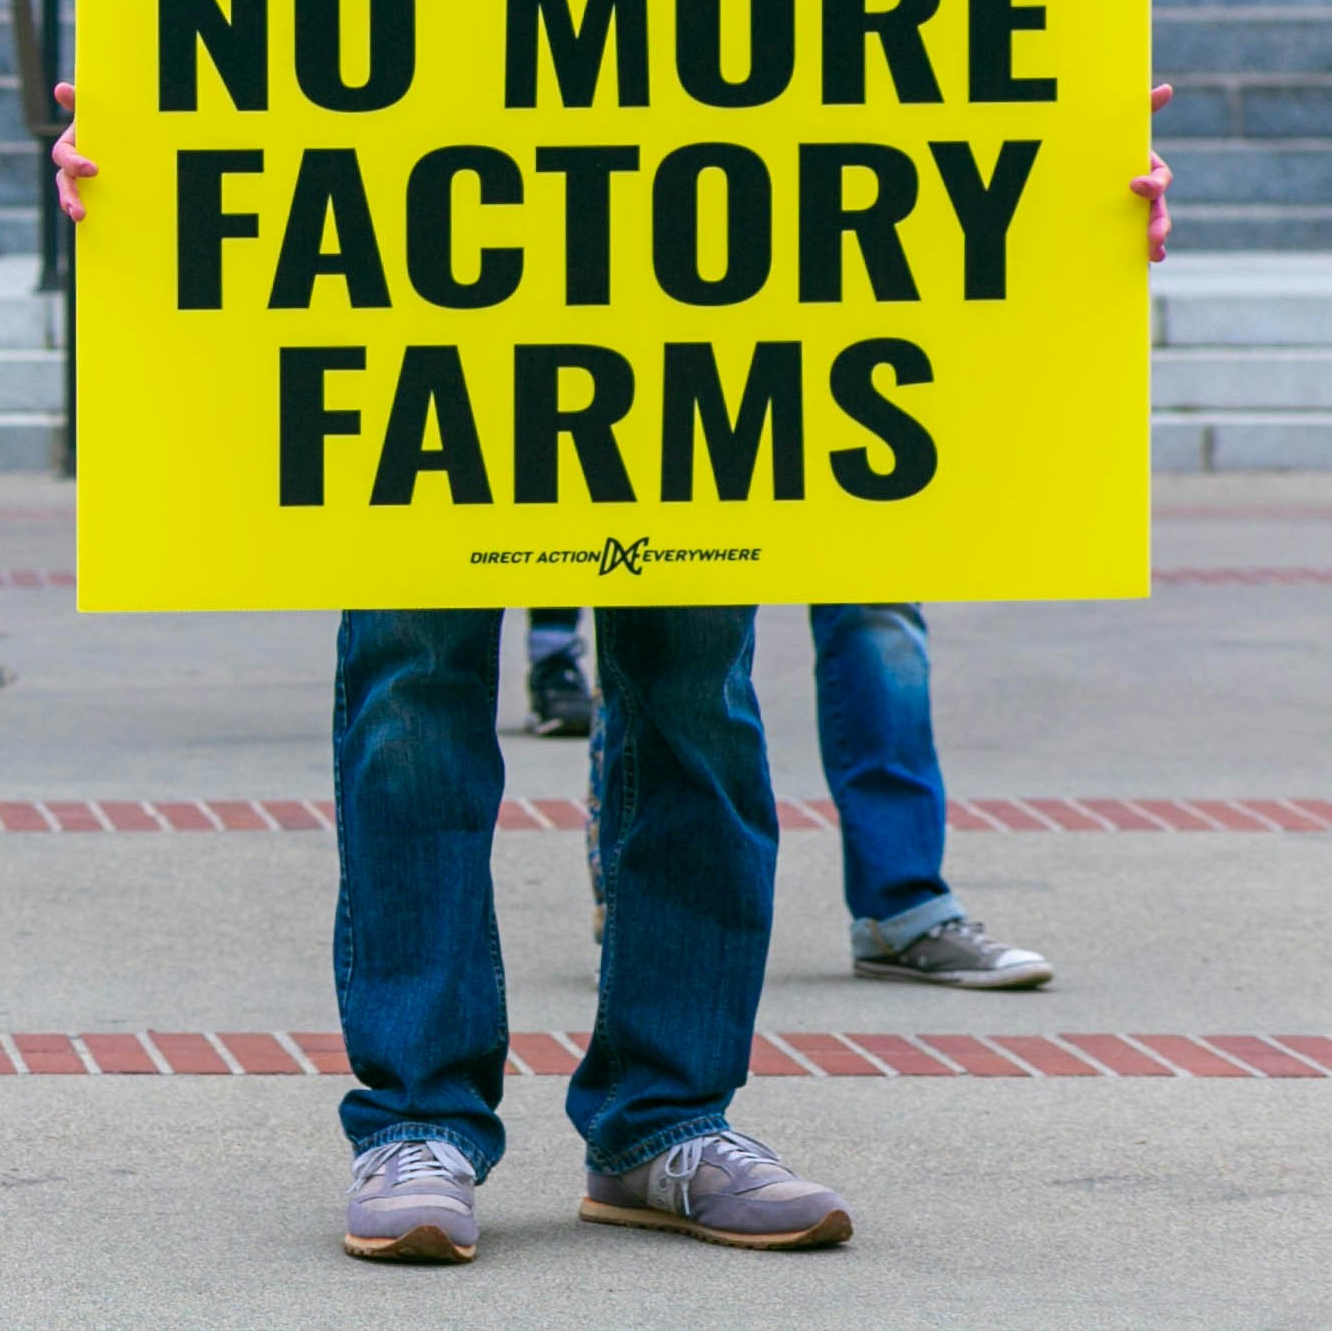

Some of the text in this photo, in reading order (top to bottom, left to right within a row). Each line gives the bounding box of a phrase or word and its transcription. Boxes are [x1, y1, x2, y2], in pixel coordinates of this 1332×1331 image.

[176, 139, 1042, 310] FACTORY
[278, 337, 939, 508] FARMS
[469, 551, 533, 564] DIRECT
[536, 550, 601, 564] ACTION
[642, 548, 761, 562] EVERYWHERE
